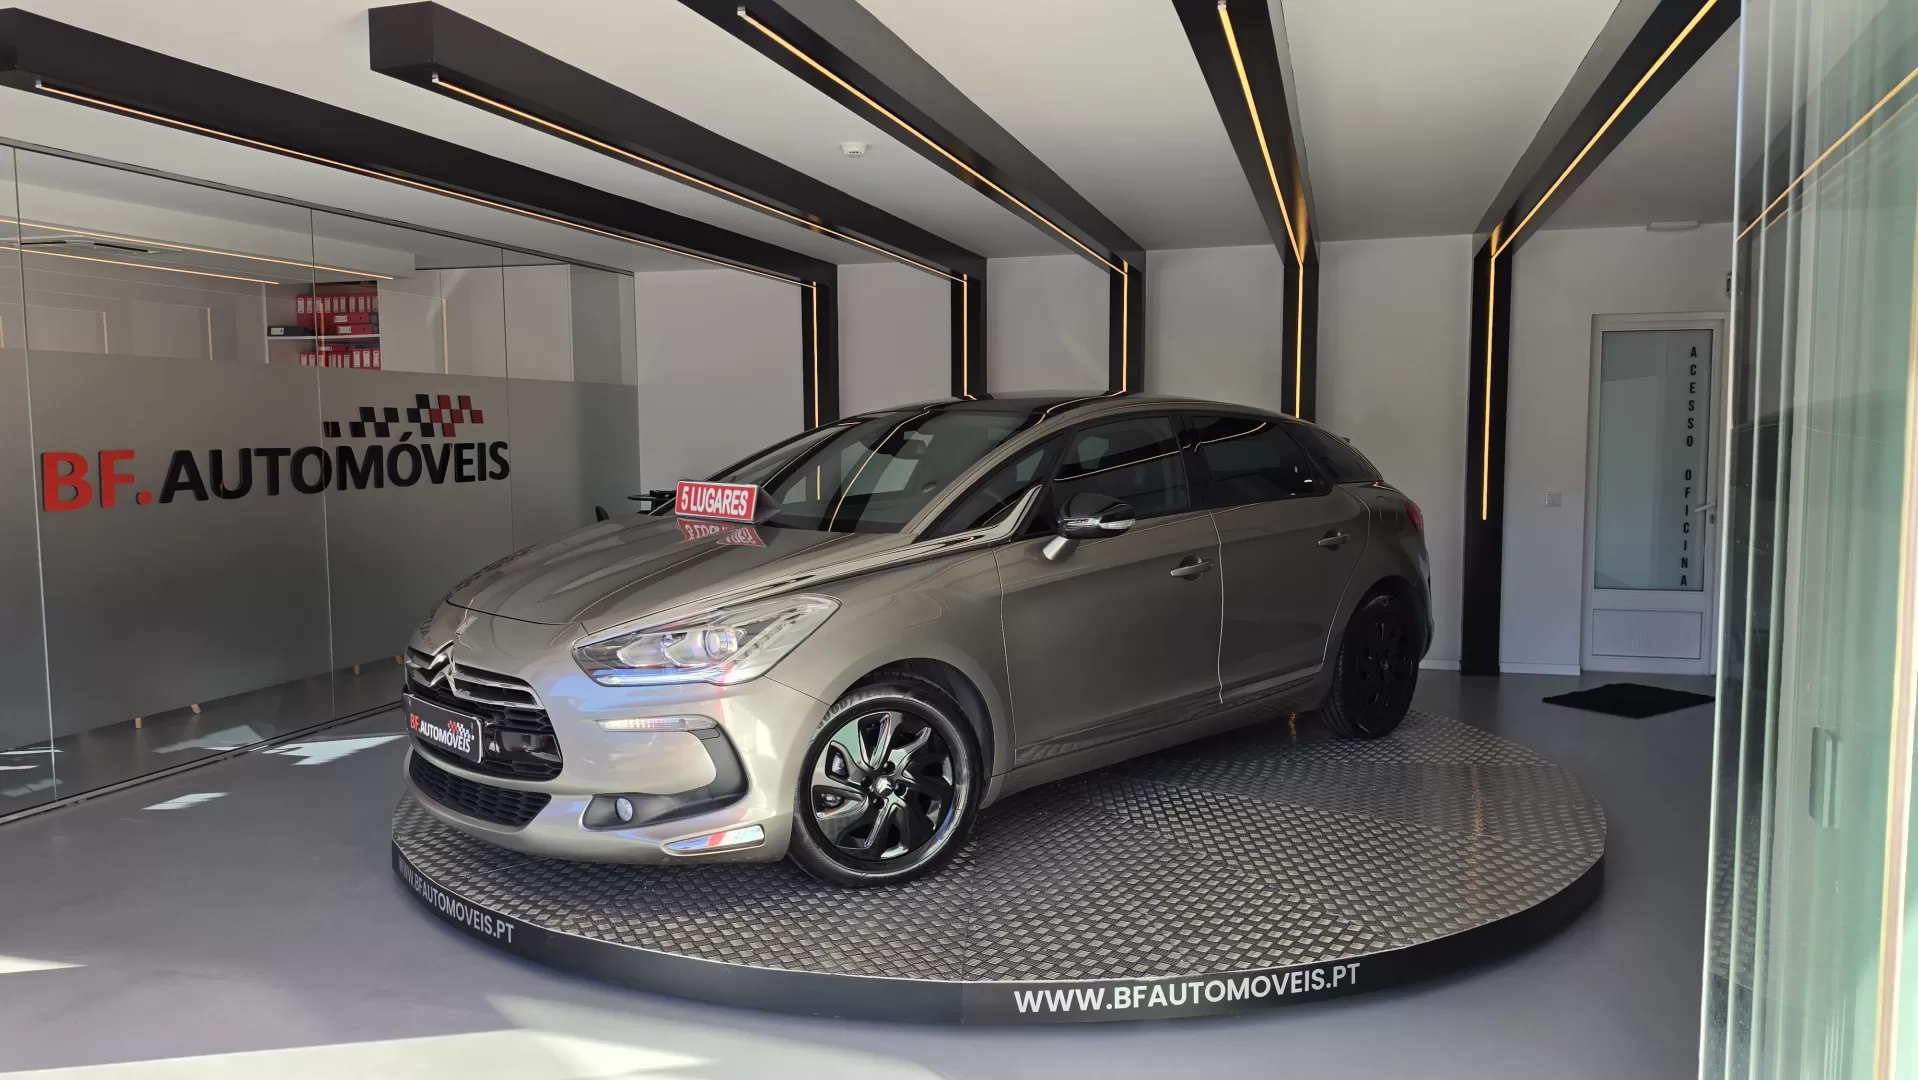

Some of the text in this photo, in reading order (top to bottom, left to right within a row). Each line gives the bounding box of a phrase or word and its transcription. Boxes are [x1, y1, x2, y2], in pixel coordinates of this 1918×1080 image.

[1680, 345, 1698, 587] ACESSO OFICINA
[681, 486, 749, 516] 5 LUGARES
[1013, 962, 1361, 1014] WWW.BFAUTOMOVEIS.PT
